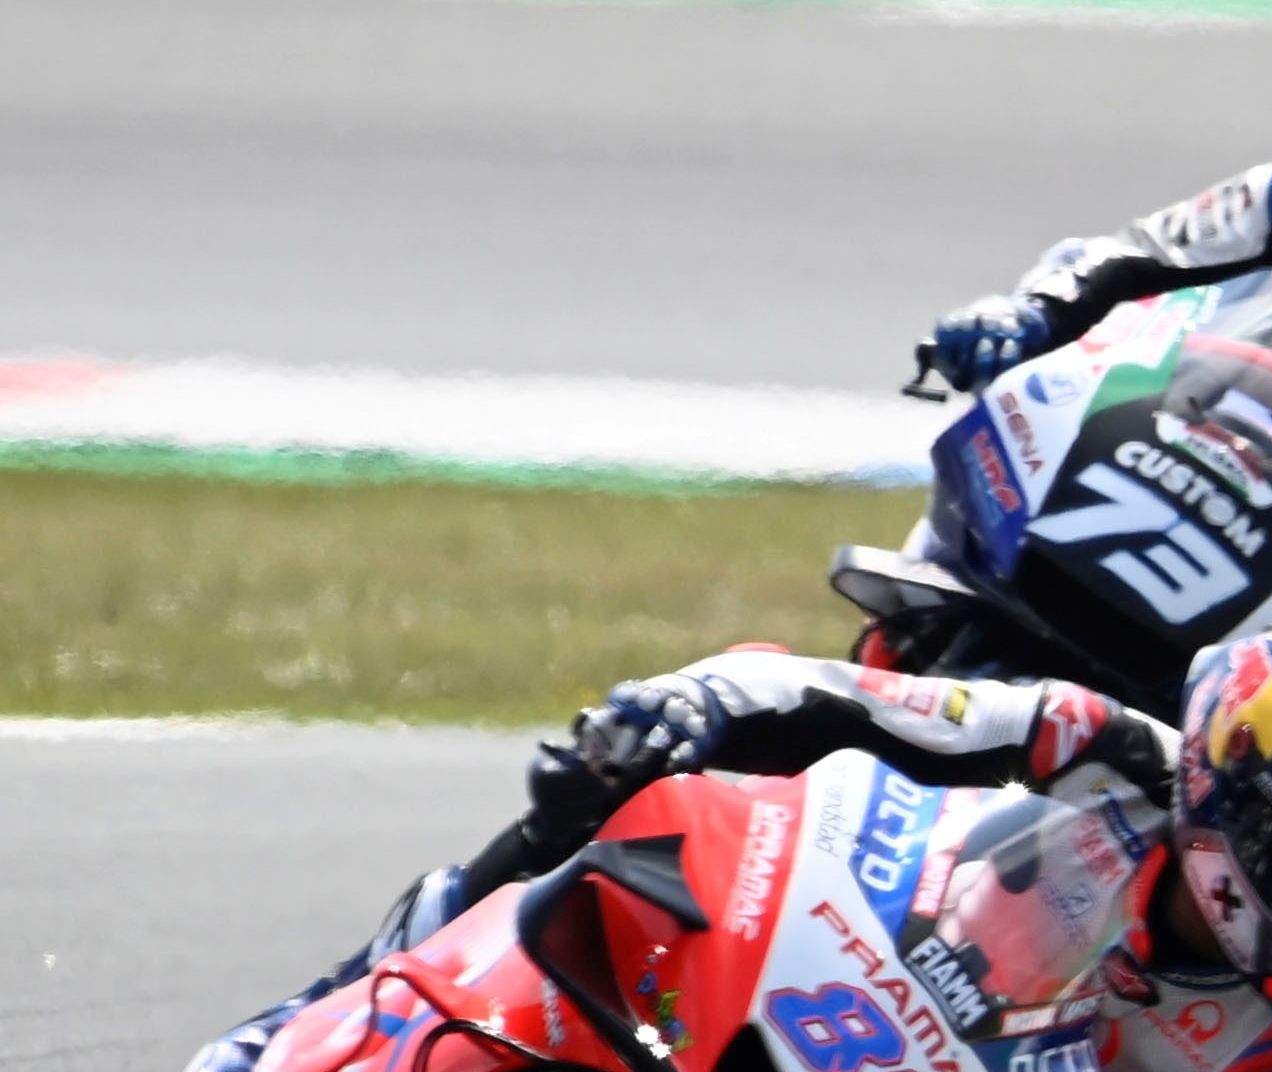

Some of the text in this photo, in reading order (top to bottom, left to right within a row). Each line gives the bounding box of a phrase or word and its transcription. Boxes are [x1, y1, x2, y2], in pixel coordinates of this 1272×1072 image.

[1025, 461, 1253, 625] 73
[1113, 440, 1267, 558] CUSTOM
[858, 772, 927, 892] OCTO
[904, 936, 990, 1029] FIAMM
